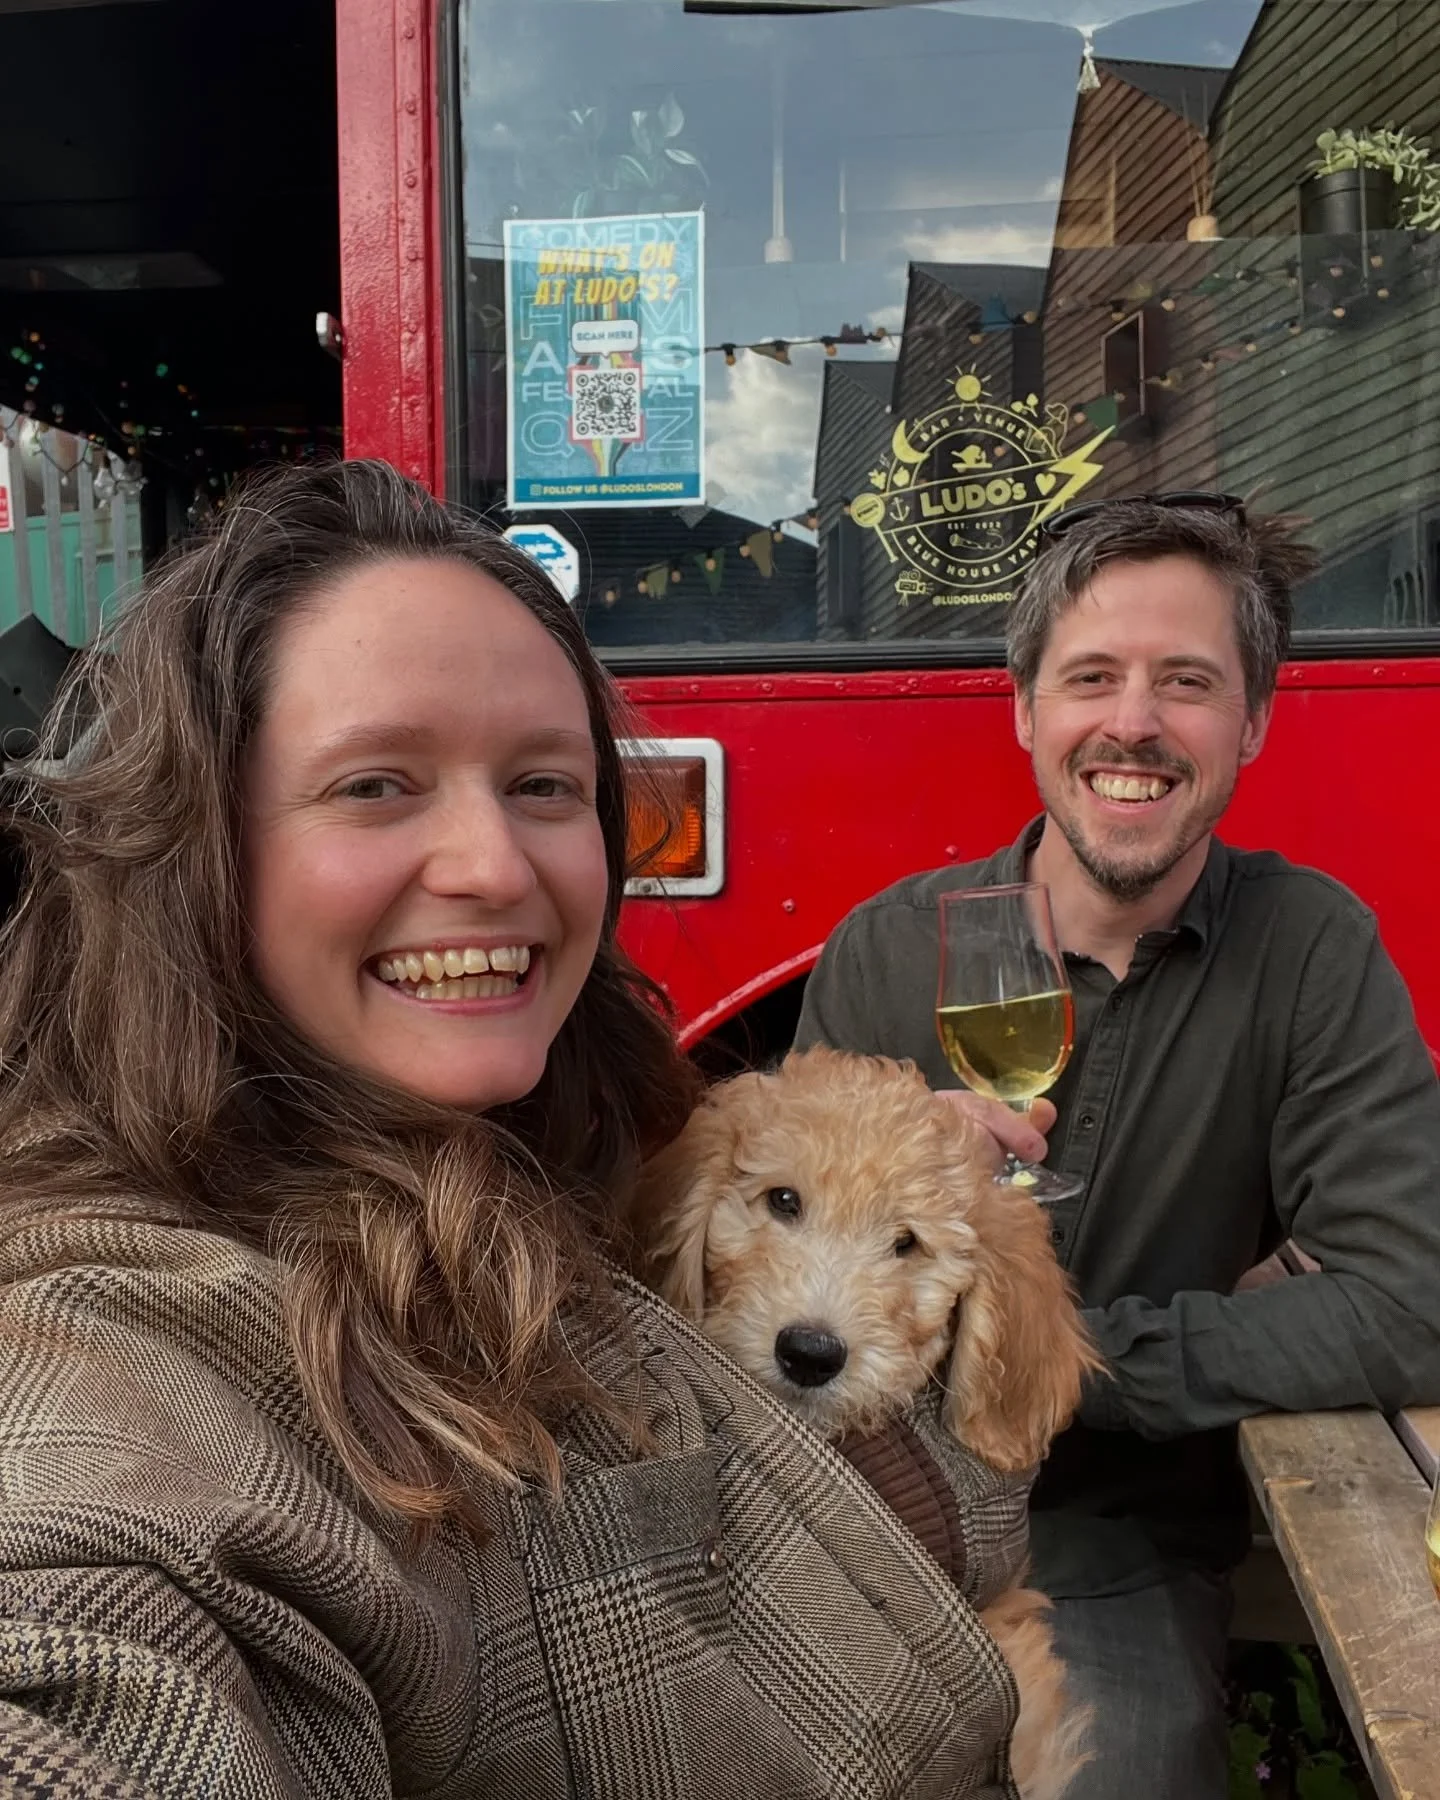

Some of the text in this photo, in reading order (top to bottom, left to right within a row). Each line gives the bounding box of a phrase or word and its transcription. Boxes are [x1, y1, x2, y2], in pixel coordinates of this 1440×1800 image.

[518, 219, 691, 249] COMEDY
[537, 244, 632, 275] WHAT'S
[639, 241, 676, 270] ON
[534, 273, 679, 306] AT LUDO'S?
[576, 330, 634, 342] SCAN HERE
[919, 412, 1026, 442] BAR VENUE
[543, 482, 684, 495] FOLLOW US @LUDOSLONDON
[906, 535, 940, 568] BLUE
[946, 563, 1002, 578] HOUSE
